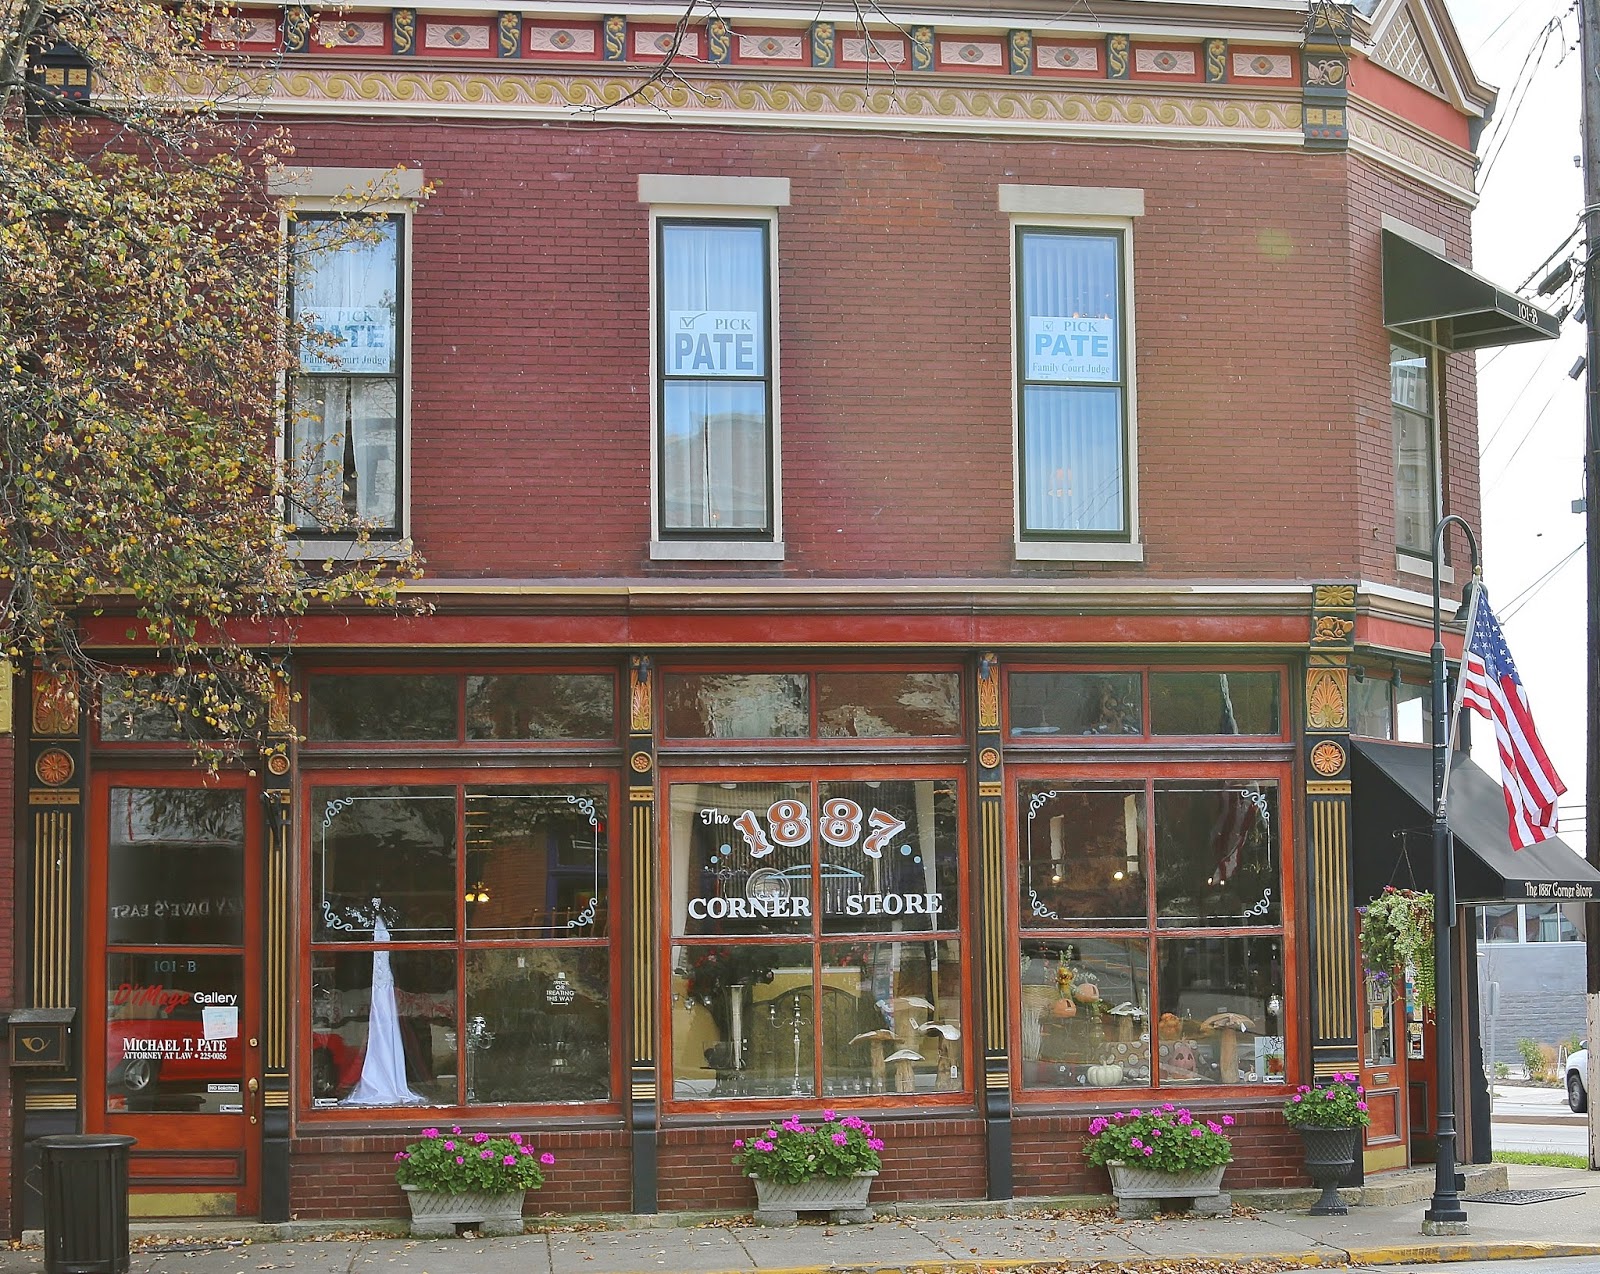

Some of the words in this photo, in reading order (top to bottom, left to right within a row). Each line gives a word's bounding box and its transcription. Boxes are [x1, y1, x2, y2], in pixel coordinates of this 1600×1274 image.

[338, 311, 373, 322] PICK
[1517, 302, 1538, 325] 101-B
[715, 318, 751, 330] PICK
[1064, 321, 1098, 332] PICK
[675, 333, 754, 370] PATE
[1035, 333, 1109, 357] PATE
[361, 355, 387, 366] Judge
[1032, 362, 1059, 374] Family
[1062, 363, 1085, 373] Court
[1086, 364, 1110, 374] Judge
[700, 808, 730, 826] The
[733, 798, 905, 858] 1887
[1525, 881, 1537, 897] The
[1539, 883, 1552, 897] 1887
[1553, 881, 1575, 898] Corner
[1576, 883, 1593, 898] Store
[688, 897, 812, 919] CORNER
[846, 893, 943, 915] STORE
[193, 991, 237, 1006] Gallery
[123, 1037, 180, 1052] MICHAEL
[183, 1038, 194, 1052] T.
[197, 1038, 227, 1052] PATE
[123, 1052, 162, 1060] ATTORNEY
[164, 1052, 175, 1060] AT
[176, 1052, 192, 1060] LAW
